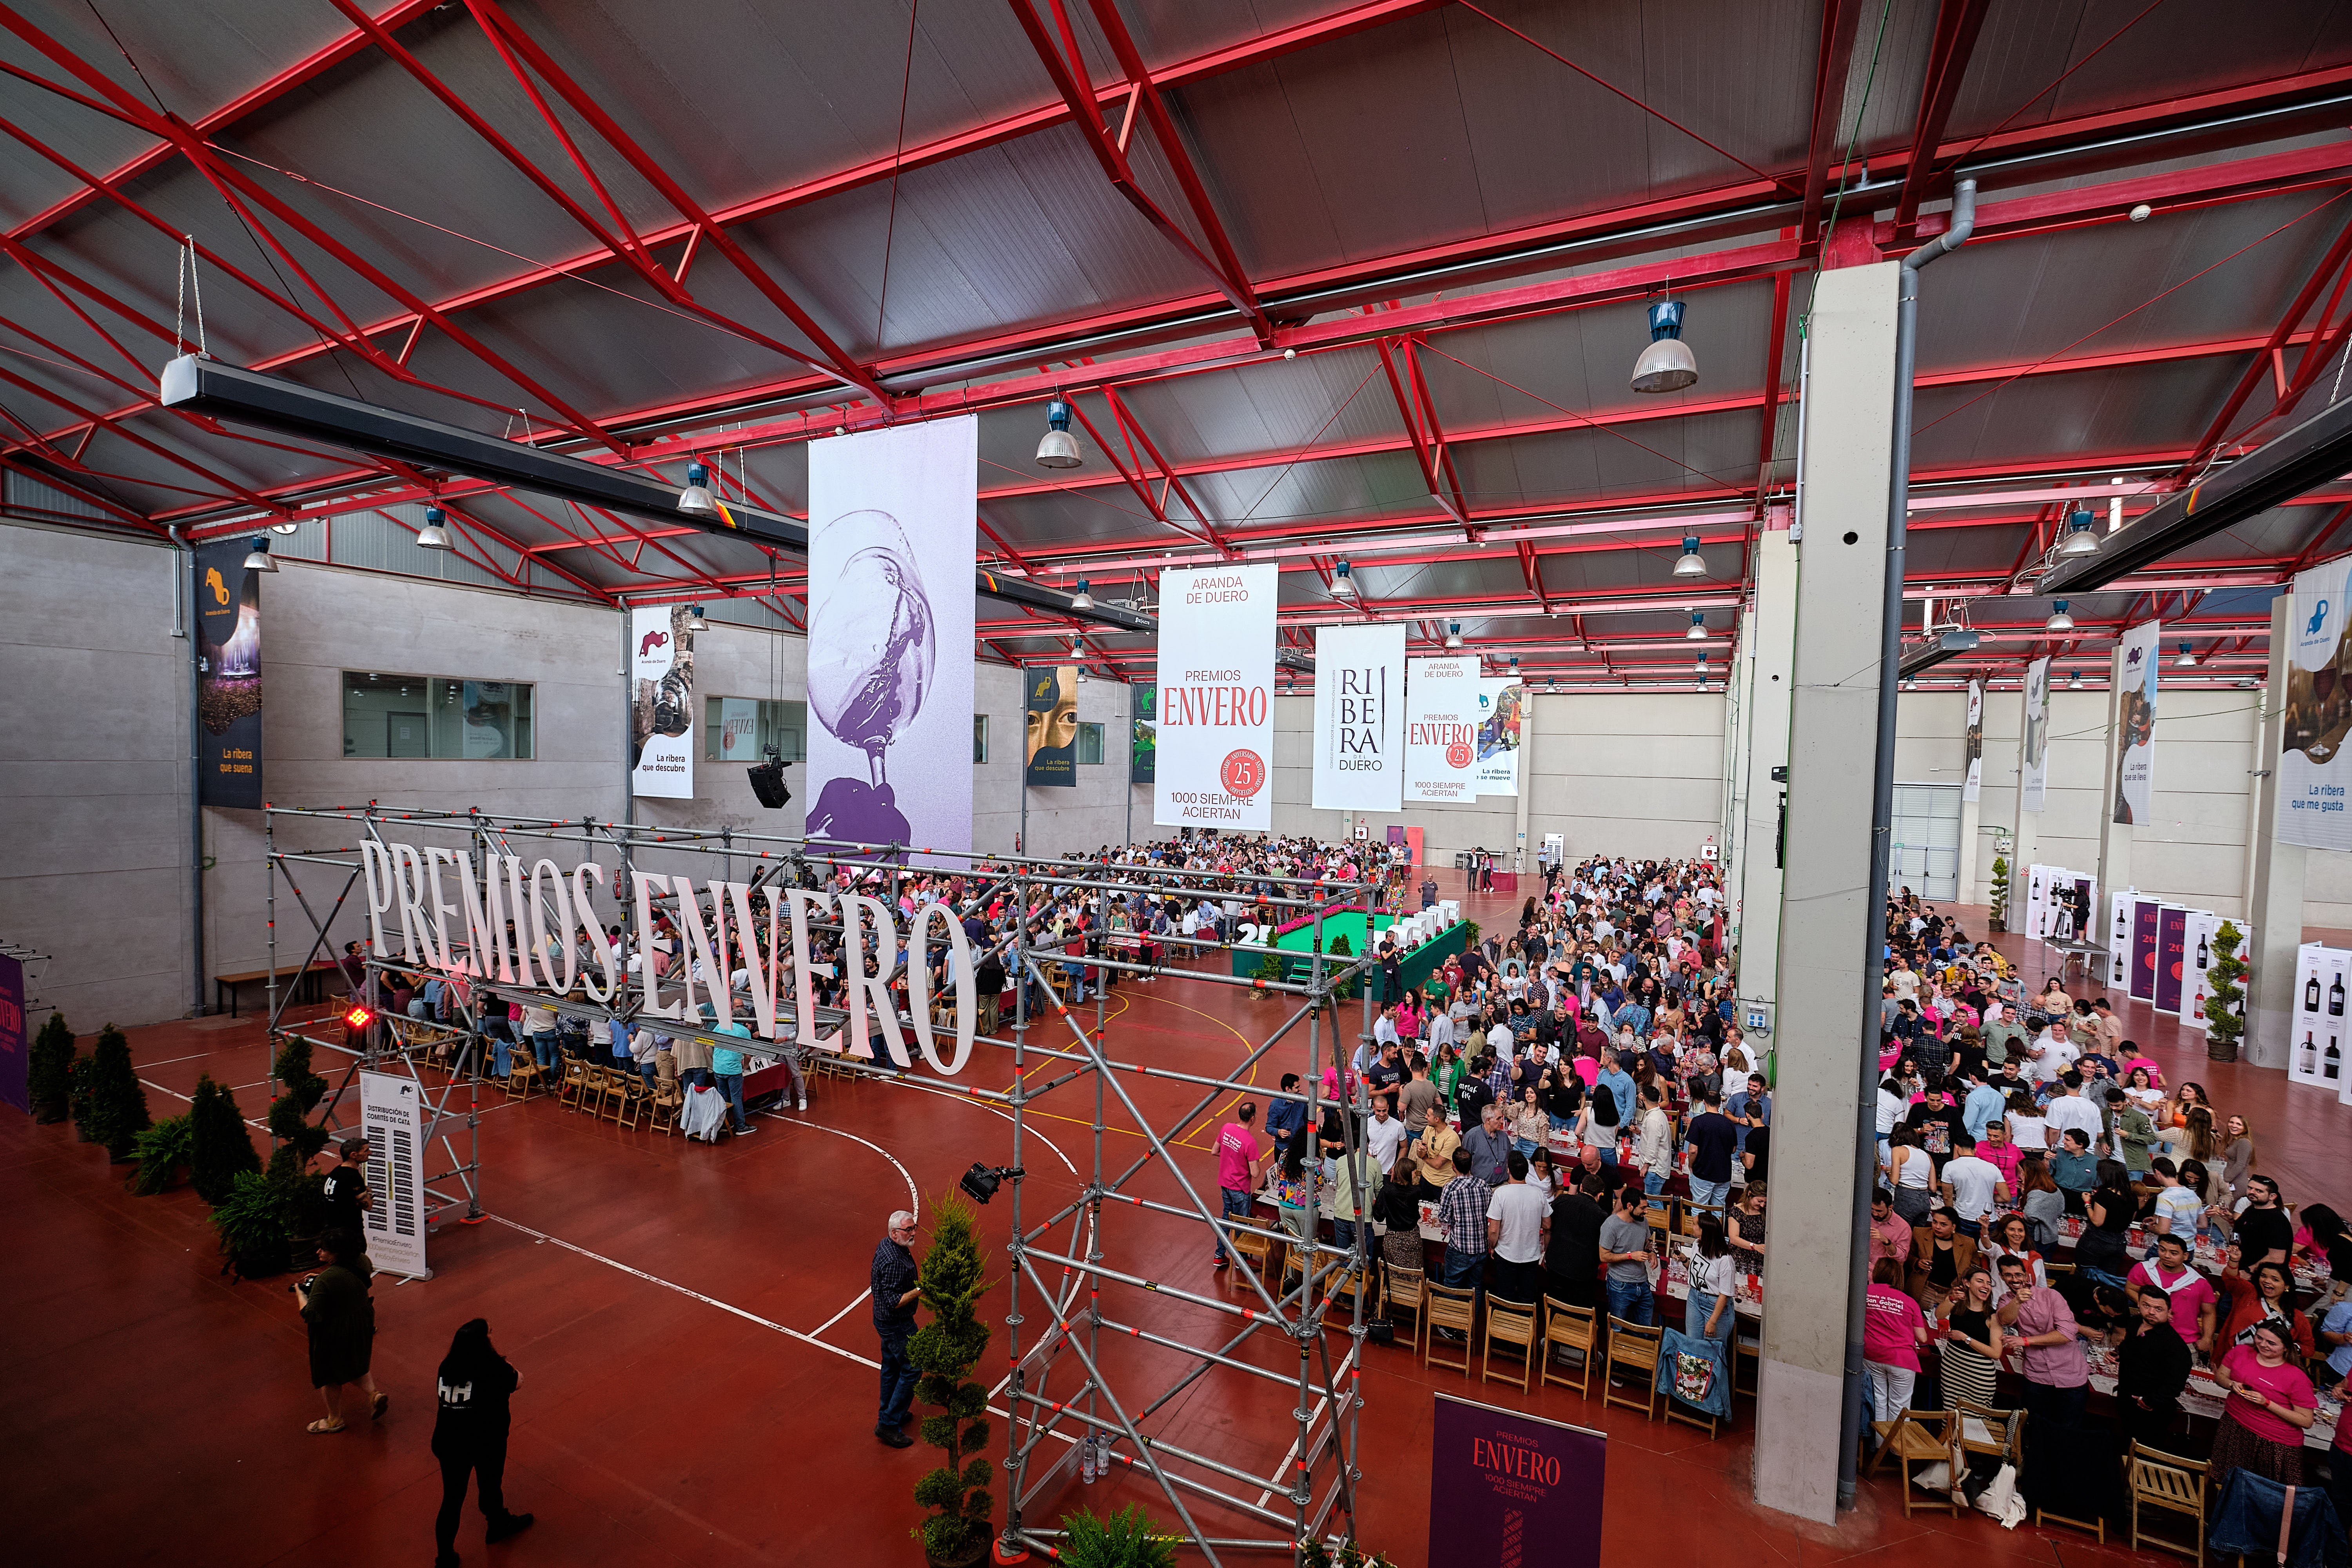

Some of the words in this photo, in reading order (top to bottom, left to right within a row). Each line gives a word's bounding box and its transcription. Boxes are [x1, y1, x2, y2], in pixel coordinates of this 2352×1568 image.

[1192, 576, 1243, 590] ARANDA
[1187, 593, 1201, 604] DE
[1206, 590, 1248, 603] DUERO
[1186, 670, 1241, 681] PREMIOS
[1163, 686, 1267, 726] ENVERO
[1410, 723, 1474, 745] ENVERO
[223, 748, 231, 759] La
[233, 748, 252, 759] ribera
[1232, 751, 1256, 760] ANIVERSARIO
[1454, 749, 1465, 761] 25
[220, 764, 232, 774] que
[233, 764, 252, 773] suena
[656, 764, 685, 772] descubre
[1339, 760, 1382, 771] DUERO
[1222, 759, 1231, 786] ANIVERSARIO
[1234, 762, 1250, 784] 25
[1254, 760, 1263, 788] ANIVERSARIO
[1230, 786, 1255, 796] ANIVERSARIO
[2309, 784, 2318, 795] La
[2321, 784, 2344, 796] ribera
[1172, 792, 1197, 803] 1000
[1200, 793, 1253, 806] SIEMPRE
[2292, 800, 2305, 810] que
[2307, 801, 2319, 809] me
[2322, 800, 2343, 812] gusta
[1183, 807, 1240, 820] ACIERTAN
[359, 840, 617, 1003] PREMIOS
[631, 871, 976, 1075] ENVERO
[755, 1060, 764, 1070] M
[1459, 1083, 1478, 1093] metal
[1462, 1091, 1470, 1100] life
[368, 1105, 402, 1116] DISTRIBUCIÓN
[367, 1112, 388, 1122] COMITÉS
[398, 1118, 410, 1126] CATA
[373, 1236, 412, 1248] #PremiosEnvero
[1879, 1299, 1903, 1310] Gabriel
[2188, 1374, 2214, 1383] SERVA
[1496, 1430, 1539, 1448] PREMIOS
[1473, 1437, 1561, 1486] ENVERO
[1485, 1474, 1504, 1485] 1000
[1506, 1479, 1546, 1497] SIEMPRE
[1493, 1484, 1537, 1503] ACIERTAN
